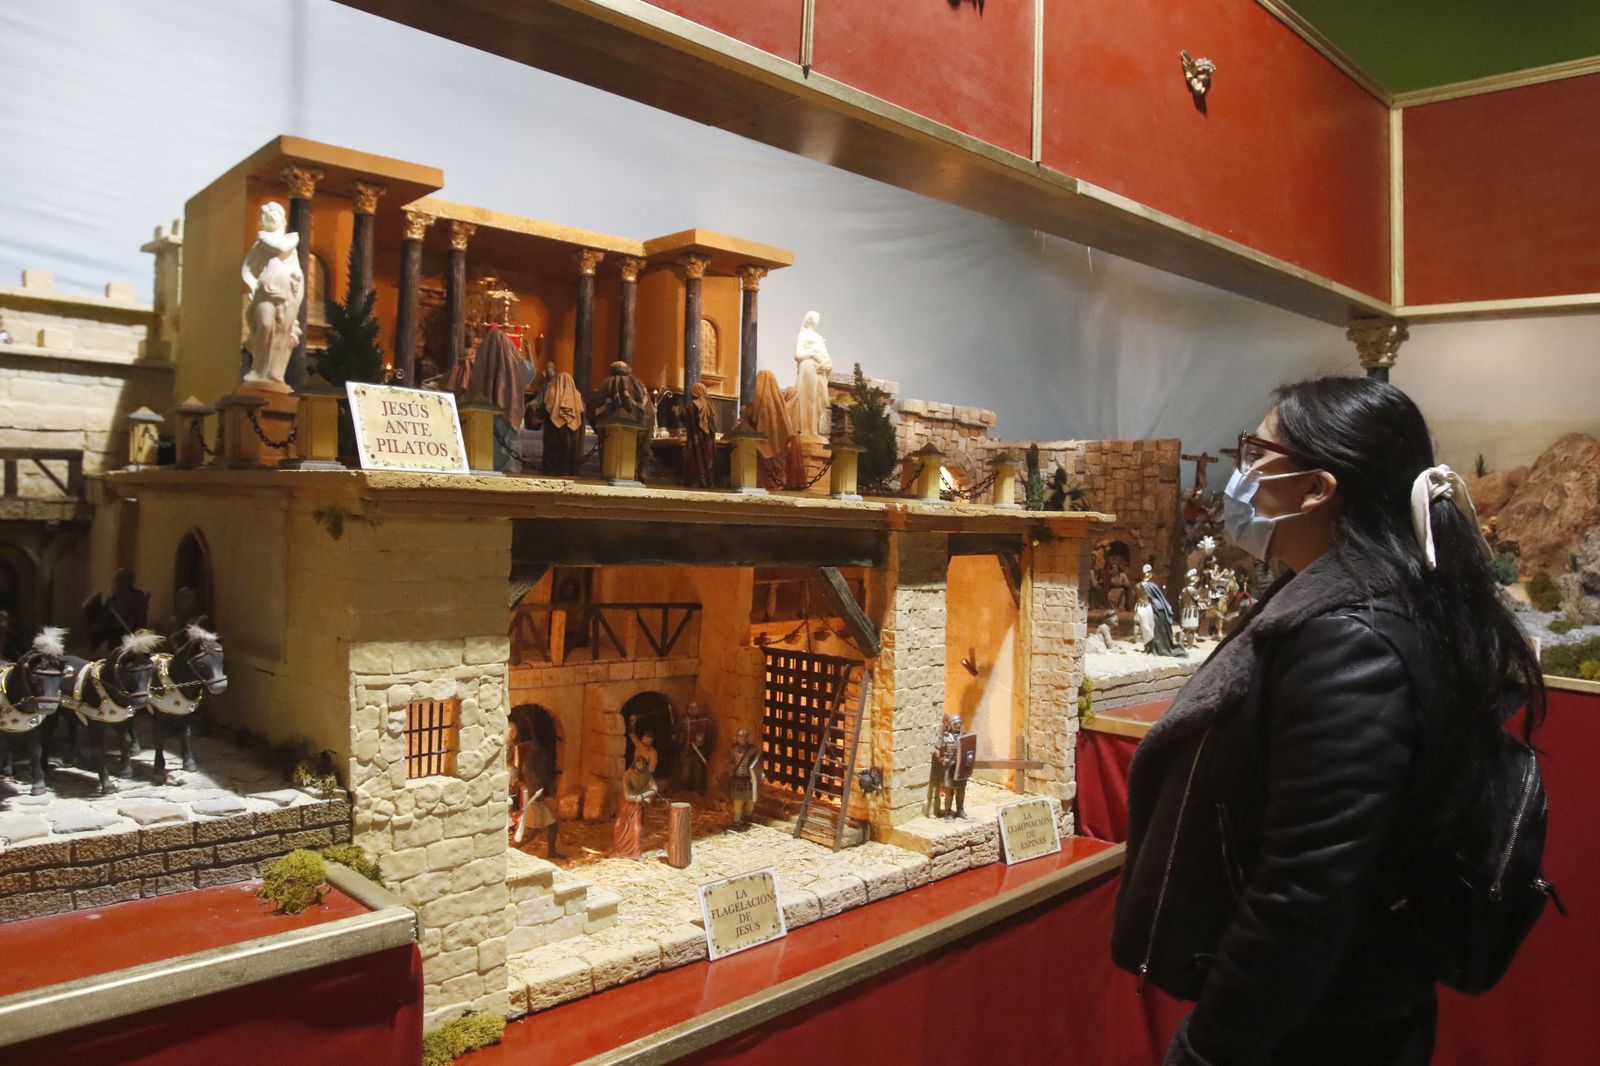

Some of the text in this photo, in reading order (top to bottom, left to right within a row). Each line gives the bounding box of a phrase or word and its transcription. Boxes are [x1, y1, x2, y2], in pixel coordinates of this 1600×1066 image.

[381, 400, 430, 418] JESÚS
[385, 420, 432, 437] ANTE
[376, 438, 448, 457] PILATOS
[1023, 812, 1033, 821] LA
[1026, 830, 1035, 839] DE
[735, 889, 748, 900] LA
[739, 911, 752, 923] DE
